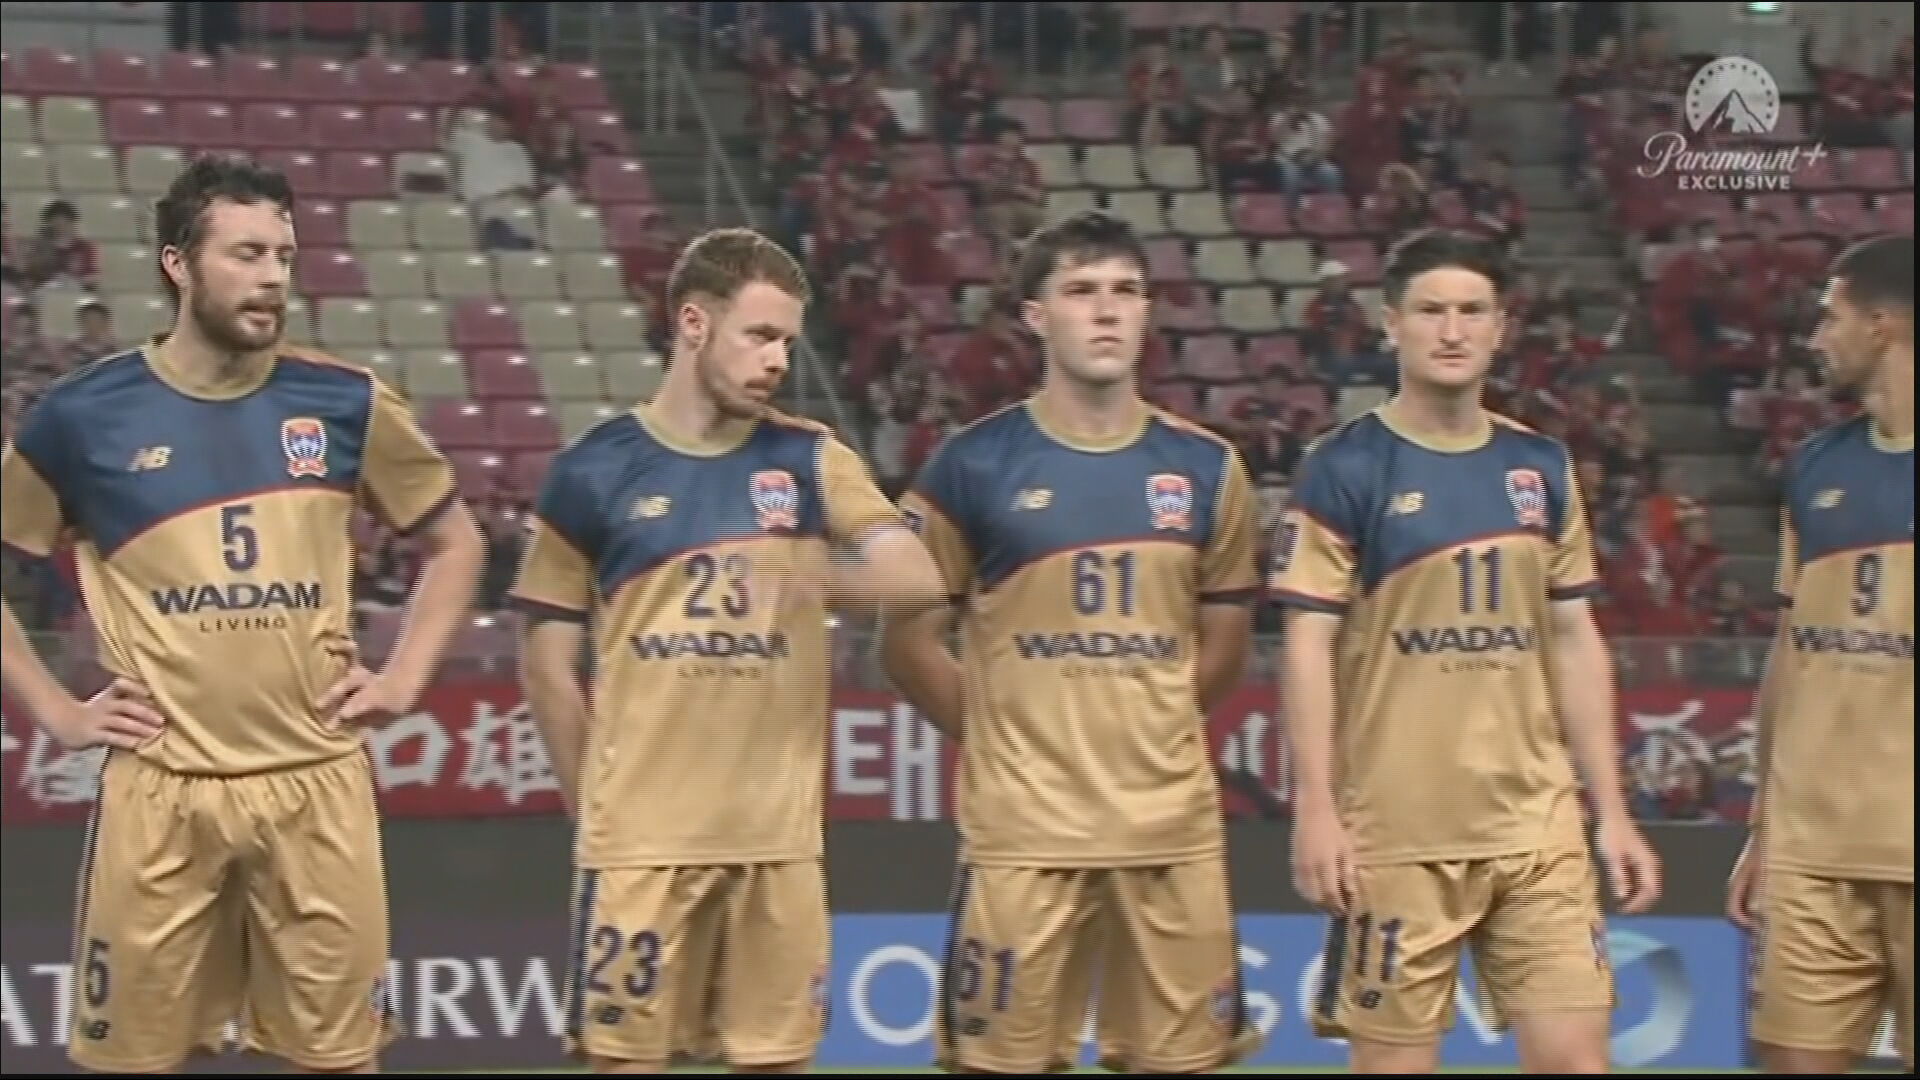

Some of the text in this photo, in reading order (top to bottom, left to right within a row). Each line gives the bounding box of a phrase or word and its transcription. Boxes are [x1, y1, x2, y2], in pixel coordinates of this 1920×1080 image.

[220, 504, 259, 571] 5
[151, 582, 321, 615] WADAM
[683, 553, 751, 619] 23
[1072, 550, 1137, 616] 61
[1452, 546, 1501, 614] 11
[1851, 554, 1880, 616] 9
[199, 616, 287, 633] LIVING
[1013, 633, 1178, 659] WADAM
[85, 938, 111, 1007] 5
[587, 926, 662, 997] 23
[1353, 912, 1402, 982] 11
